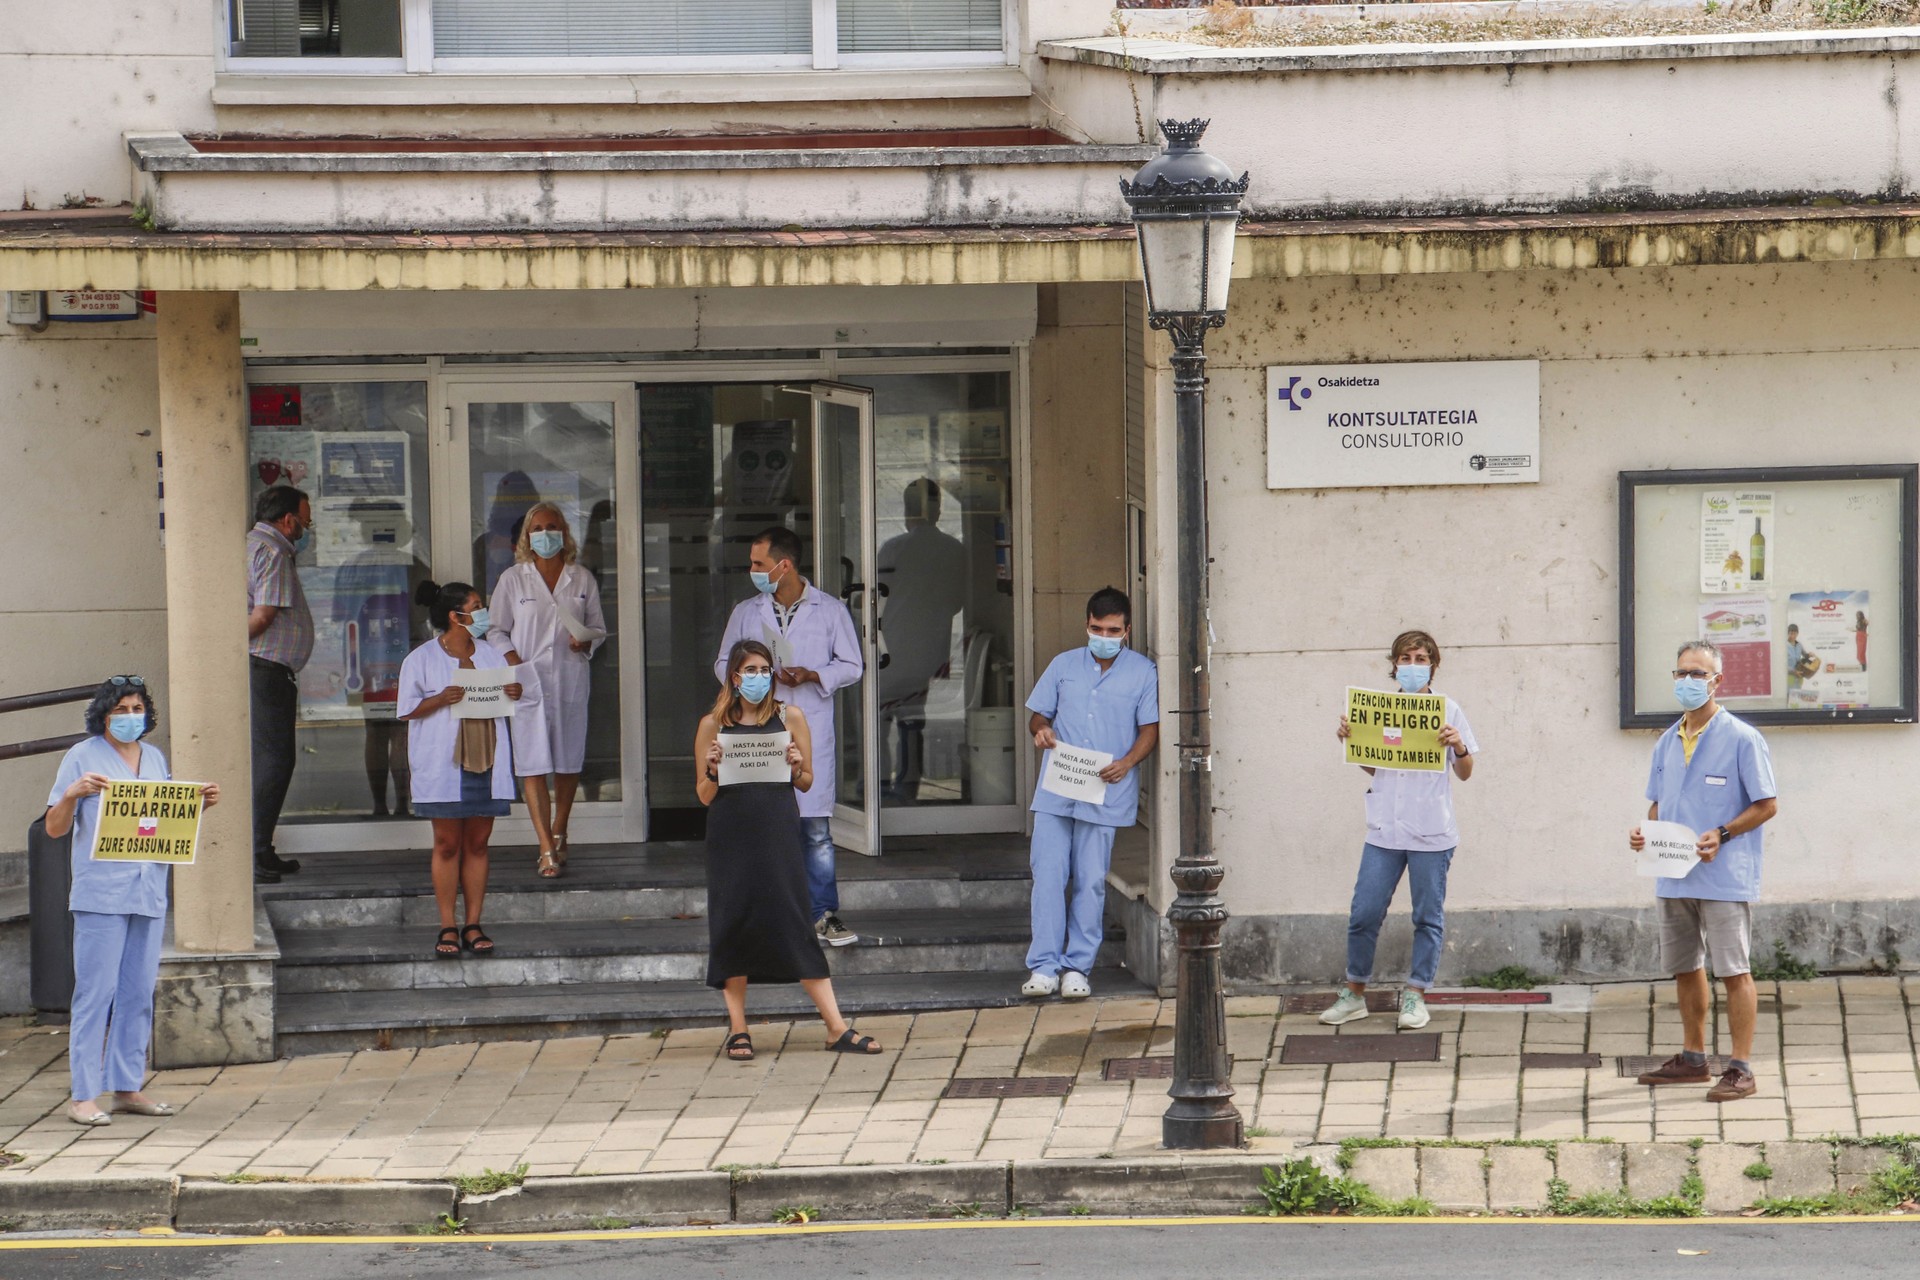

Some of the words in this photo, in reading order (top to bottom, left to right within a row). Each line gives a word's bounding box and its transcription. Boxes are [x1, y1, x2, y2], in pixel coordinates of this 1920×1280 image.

[1318, 377, 1380, 387] Osakidetza
[1328, 410, 1478, 427] KONTSULTATEGIA
[1341, 431, 1464, 449] CONSULTORIO
[478, 685, 504, 693] RECURSO
[1352, 692, 1392, 709] ATENCIÓN
[1395, 698, 1441, 712] PRIMARIA
[1350, 708, 1367, 724] EN
[1374, 711, 1441, 730] PELIGRO
[1060, 752, 1078, 763] HASTA
[1080, 758, 1097, 767] AQUÍ
[1350, 745, 1362, 757] TU
[1365, 746, 1393, 761] SALUD
[1397, 749, 1441, 764] TAMBIÉN
[1053, 760, 1071, 771] HEMOS
[1072, 766, 1100, 778] LLEGADO
[1059, 774, 1073, 783] ASKI
[1073, 778, 1086, 786] DA!
[112, 785, 147, 798] LEHEN
[153, 786, 195, 800] ARRETA
[105, 801, 197, 819] ITOLARRIAN
[98, 837, 125, 853] ZURE
[127, 838, 171, 855] OSASUNA
[174, 839, 191, 855] ERE
[1651, 840, 1668, 848] MÁS
[1669, 841, 1694, 851] RECURSOS
